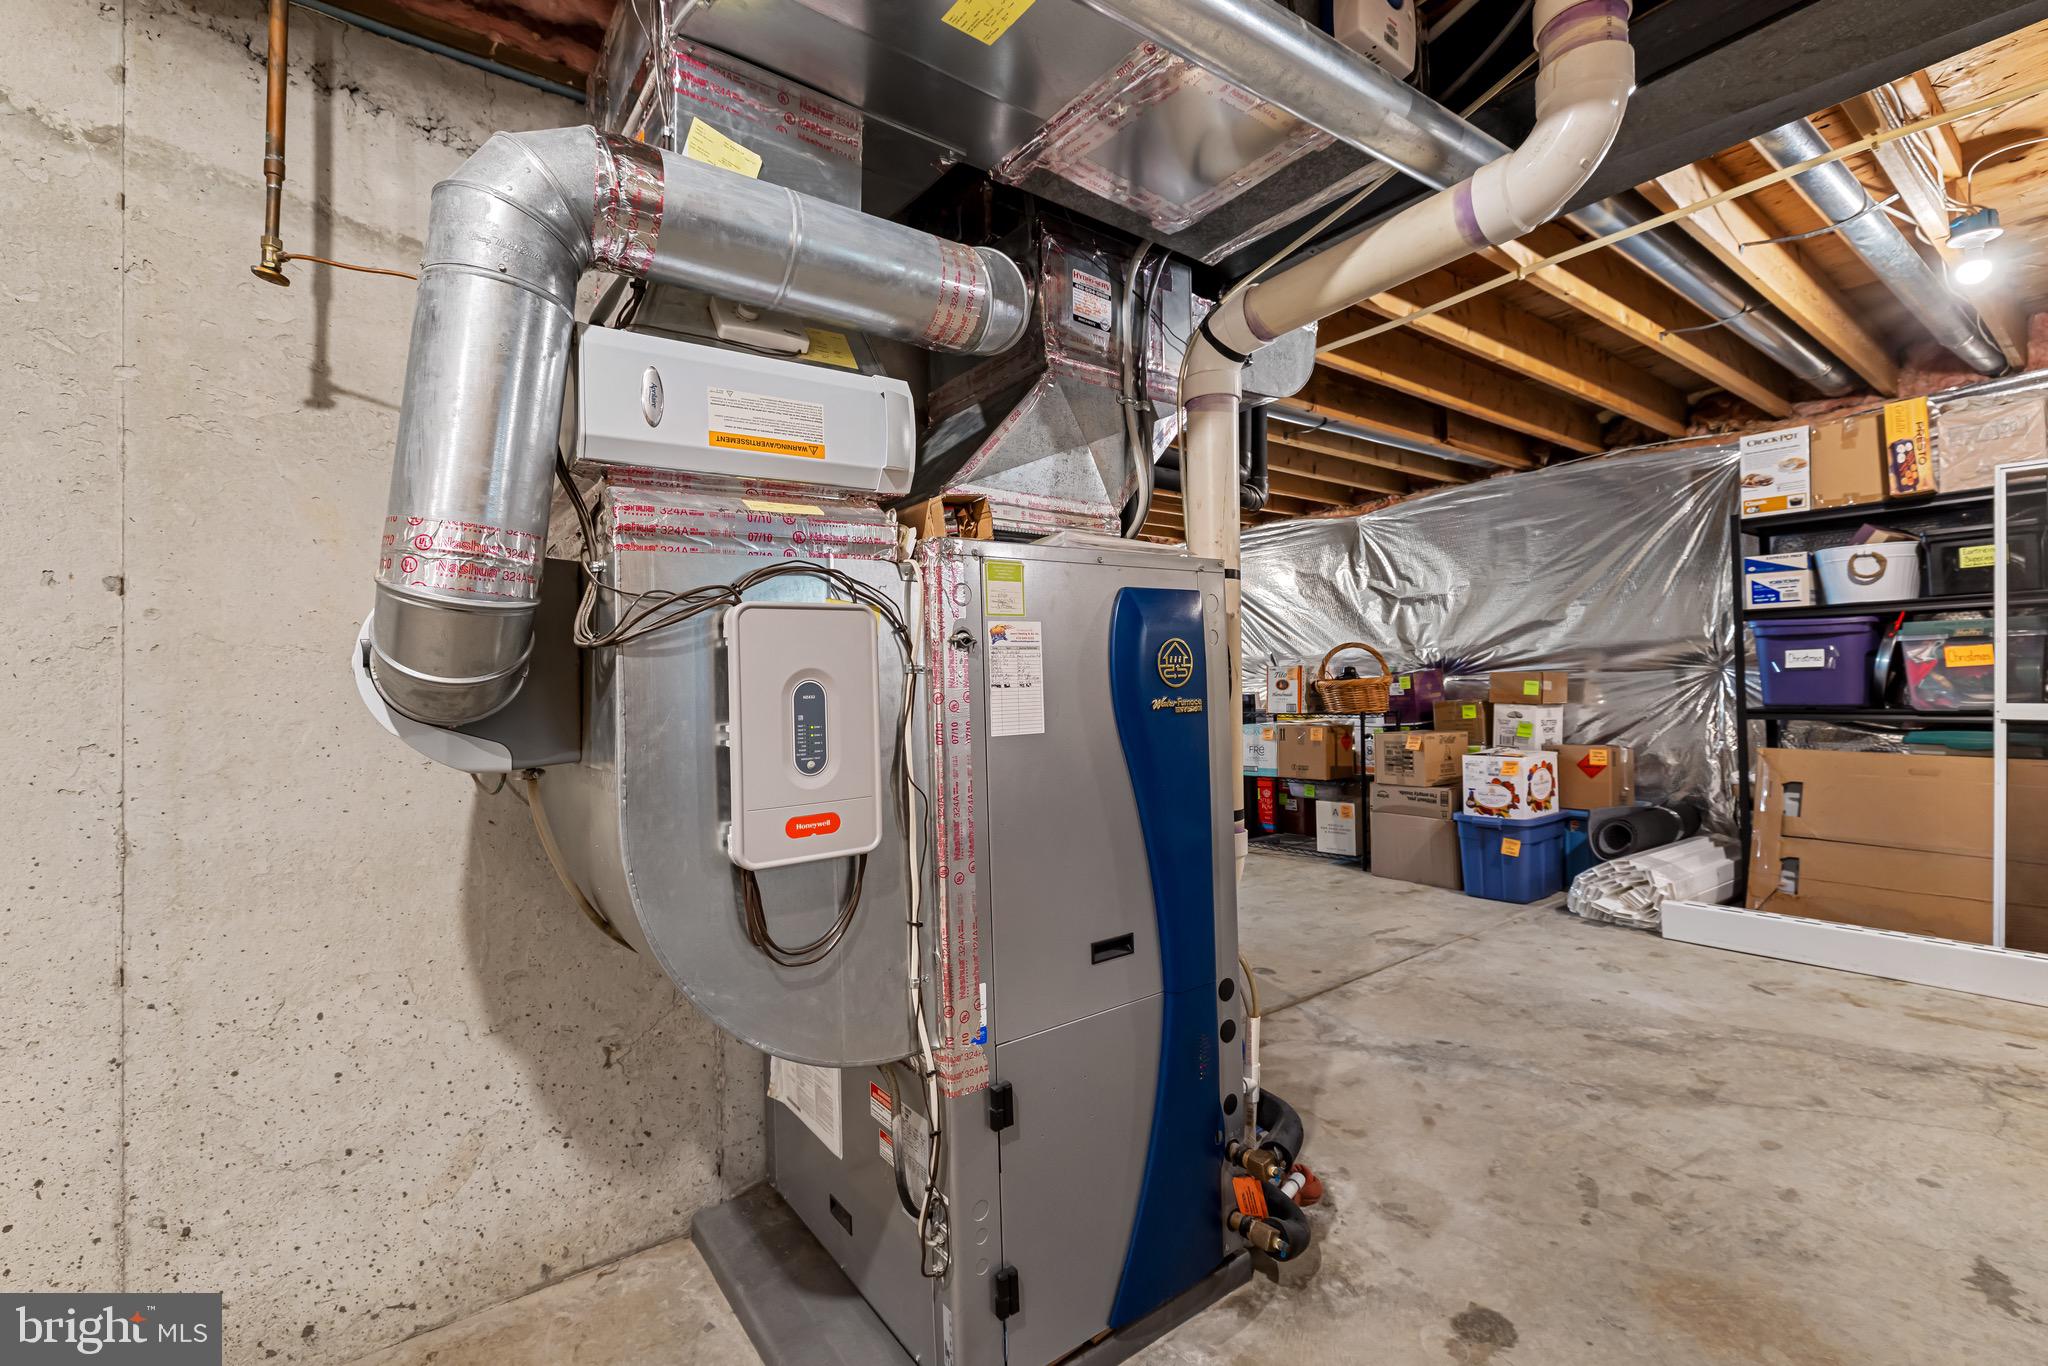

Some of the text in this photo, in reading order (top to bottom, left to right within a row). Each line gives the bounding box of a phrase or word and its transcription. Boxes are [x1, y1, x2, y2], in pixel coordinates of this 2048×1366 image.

[716, 435, 808, 452] WARNING/AVERTISSEMENT
[660, 525, 689, 536] 324A
[748, 532, 772, 544] 07/10
[440, 536, 501, 556] Nashua
[505, 547, 530, 560] 324A
[435, 559, 499, 578] Nashua
[502, 570, 529, 584] 324A
[1788, 653, 1824, 664] Christmas
[1948, 650, 1992, 663] Christmas
[951, 722, 960, 745] 07/10
[952, 795, 961, 818] 324A
[796, 819, 831, 830] Honeywell
[957, 932, 966, 956] 324A
[958, 958, 967, 1001] Nashua
[965, 1066, 985, 1078] 324A
